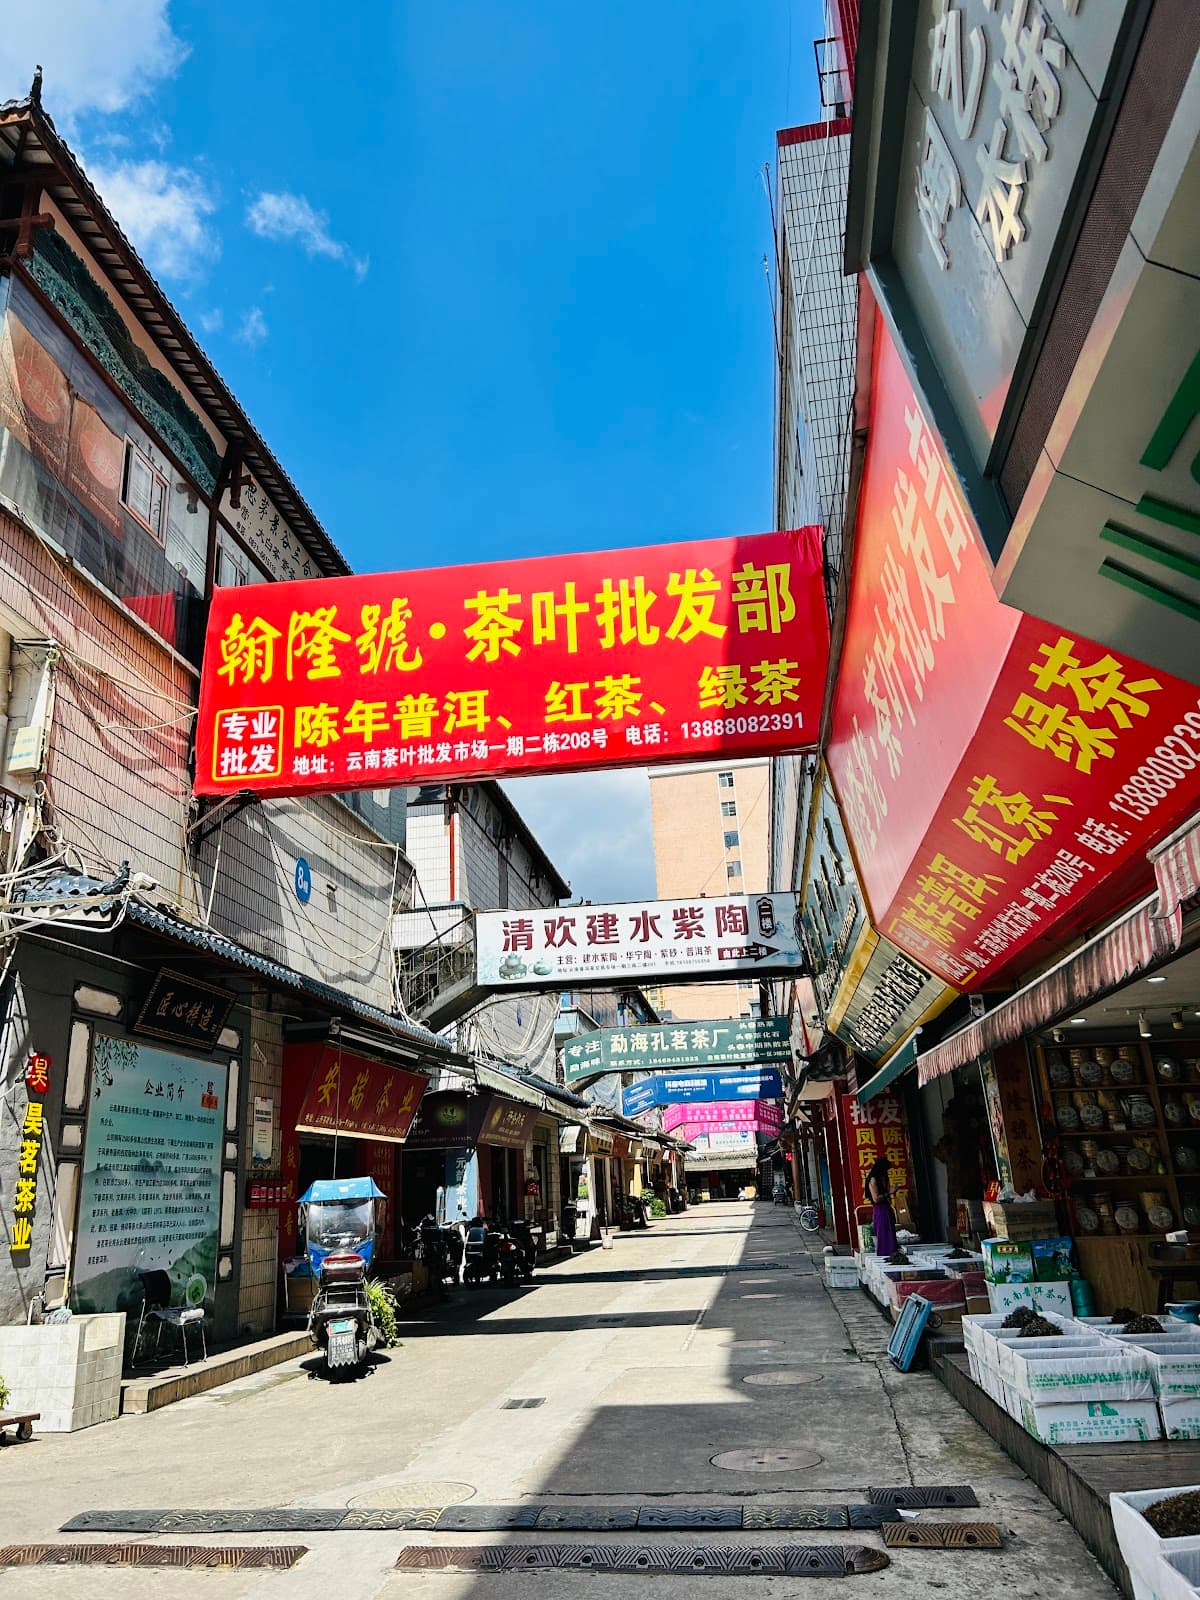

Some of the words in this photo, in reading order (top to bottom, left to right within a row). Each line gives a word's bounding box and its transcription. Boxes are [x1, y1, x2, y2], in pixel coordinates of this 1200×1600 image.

[698, 658, 801, 709] 绿茶
[1003, 636, 1164, 775] 绿茶
[221, 711, 277, 742] 专业
[680, 711, 804, 740] 13888082391
[220, 747, 276, 775] 批发
[502, 904, 750, 952] 清欢建水紫陶
[760, 904, 774, 930] 二楼
[568, 1040, 601, 1057] 专注
[610, 1028, 729, 1054] 勐海孔茗茶厂
[850, 1099, 902, 1126] 批发
[10, 1102, 43, 1251] 昊茗茶业
